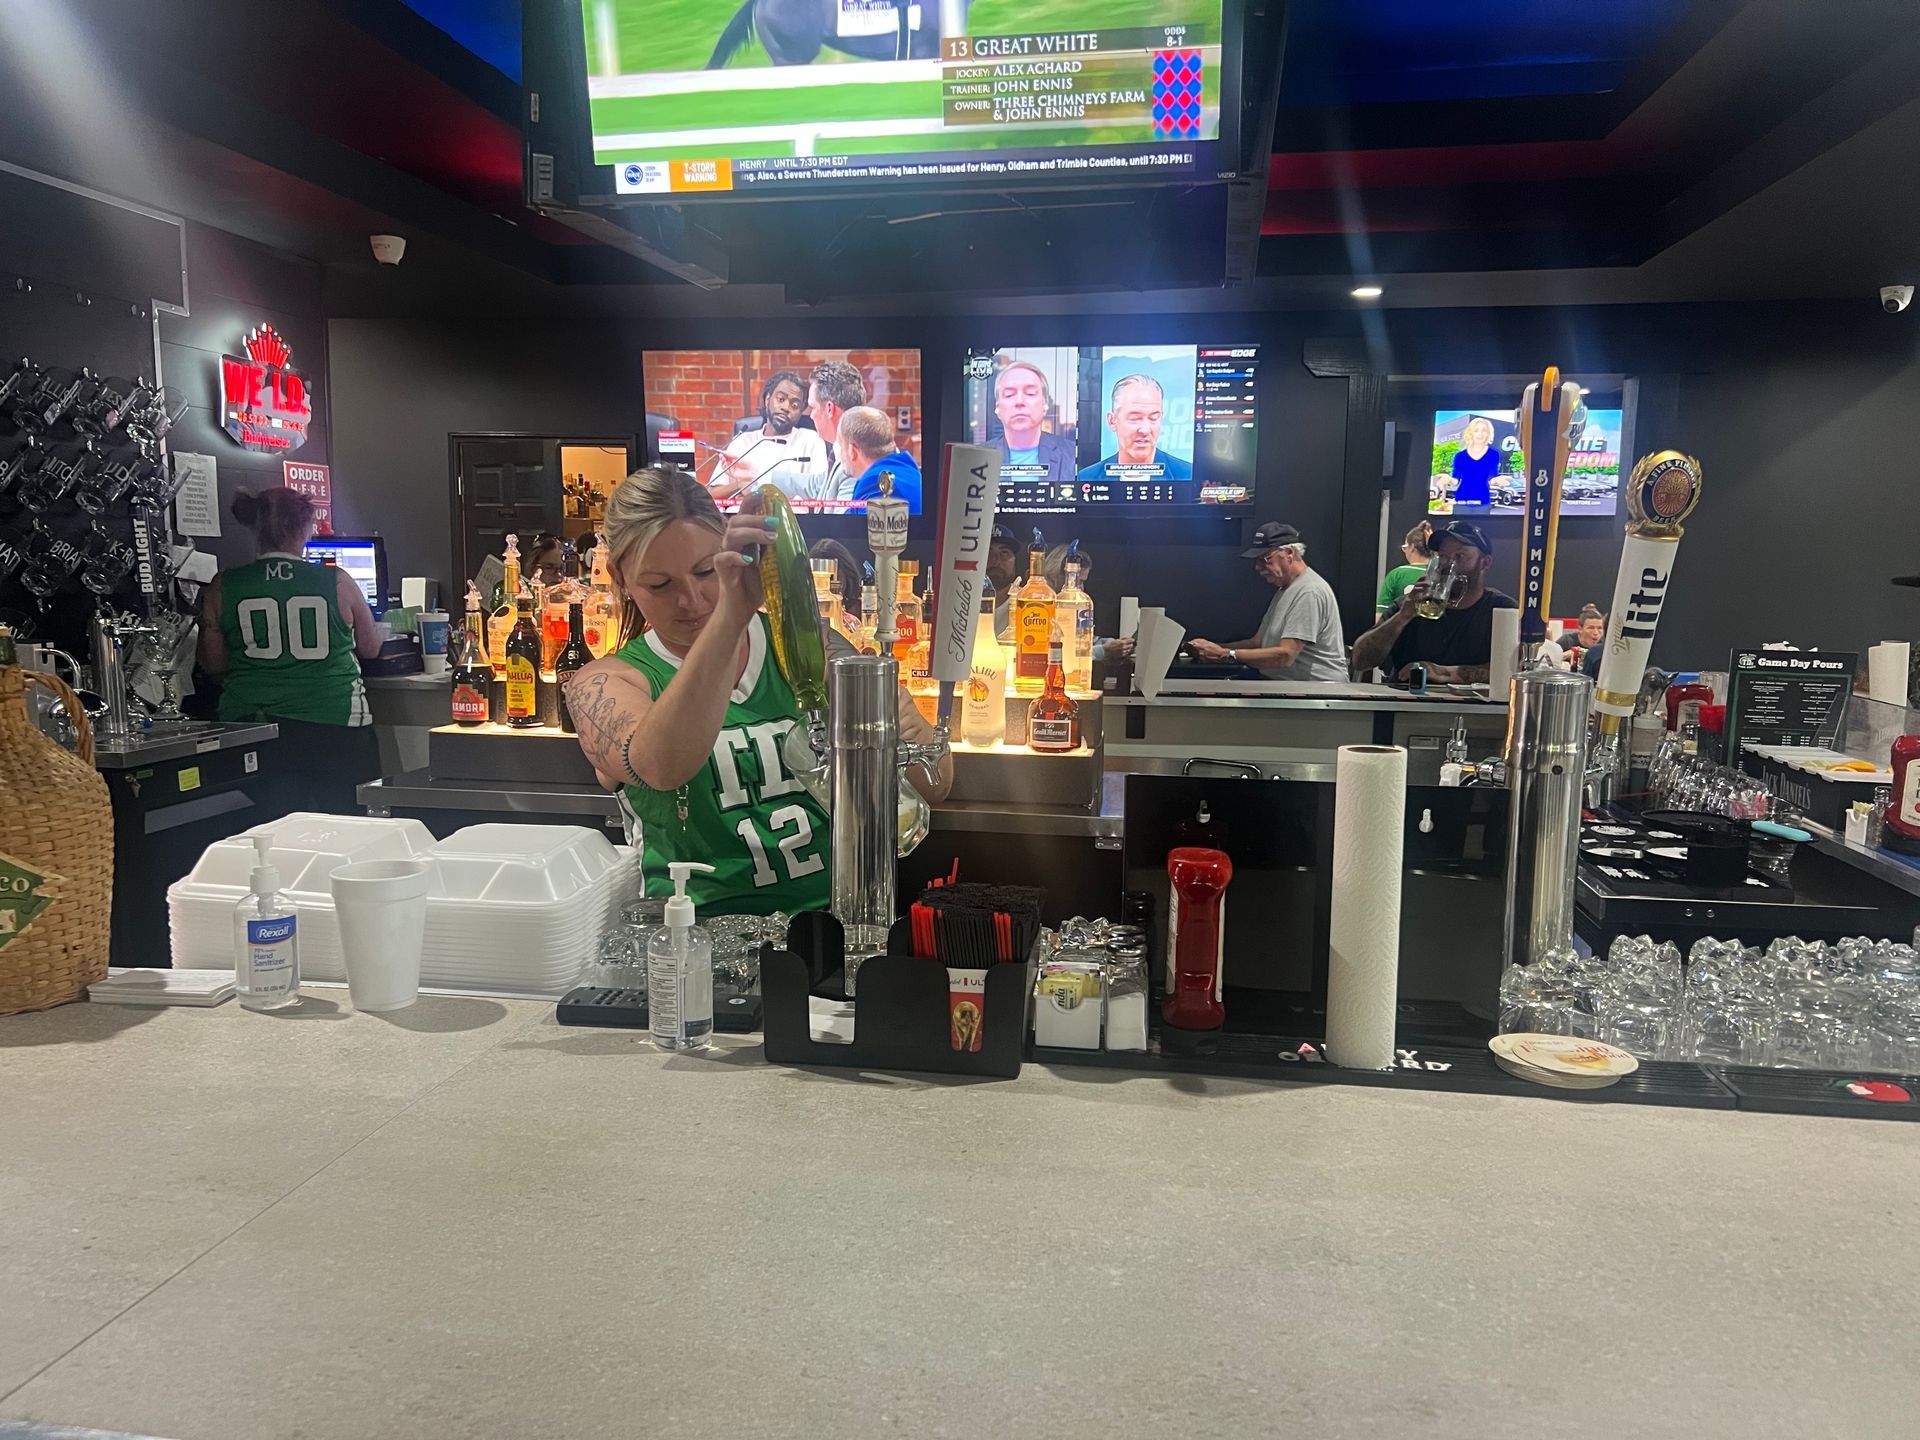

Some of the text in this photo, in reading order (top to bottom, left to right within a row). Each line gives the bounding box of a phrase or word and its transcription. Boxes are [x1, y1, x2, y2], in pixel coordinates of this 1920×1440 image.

[1164, 26, 1186, 36] ODDS
[950, 34, 1098, 57] 13 GREAT WHITE
[1166, 36, 1183, 47] 8-1
[956, 61, 1082, 79] JOCKEY: ALEX ACHARD
[950, 78, 1073, 95] TRAINER: JOHN ENNIS
[955, 91, 1146, 111] OWNER: THREE CHIMNEYS FARM
[993, 105, 1085, 122] & JOHN ENNIS
[684, 161, 716, 173] T-STORM
[739, 156, 848, 169] HENRY UNTIL 7:30 PM EDT
[743, 172, 756, 182] ng.
[757, 171, 777, 182] Also,
[784, 170, 811, 179] Severe
[812, 167, 868, 178] Thunderstorm
[868, 166, 901, 179] Warning
[903, 166, 917, 175] has
[918, 164, 938, 174] been
[940, 163, 966, 174] issued
[967, 162, 979, 173] for
[981, 161, 1006, 175] Henry,
[1008, 160, 1039, 171] Oldham
[1040, 159, 1055, 170] and
[1056, 157, 1088, 169] Trimble
[1089, 156, 1128, 168] Counties,
[1130, 155, 1148, 166] until
[1149, 154, 1168, 165] 7:30
[1170, 154, 1183, 164] PM
[684, 172, 717, 183] WARNING
[1231, 349, 1256, 357] EDGE
[223, 359, 309, 416] WE I.D.
[242, 428, 291, 449] Budweiser
[289, 467, 325, 482] ORDER
[1534, 469, 1548, 537] BLUE
[315, 509, 328, 520] UP
[133, 518, 154, 594] BUD LIGHT
[948, 462, 989, 664] Michelob ULTRA
[1527, 547, 1542, 609] MOON
[236, 594, 331, 661] 00
[1023, 615, 1047, 627] Cuervo
[1758, 658, 1844, 670] Game Day Pours
[736, 804, 825, 888] 12
[259, 925, 290, 939] Rexall
[254, 952, 274, 960] Hand
[254, 958, 286, 967] Sanitizer
